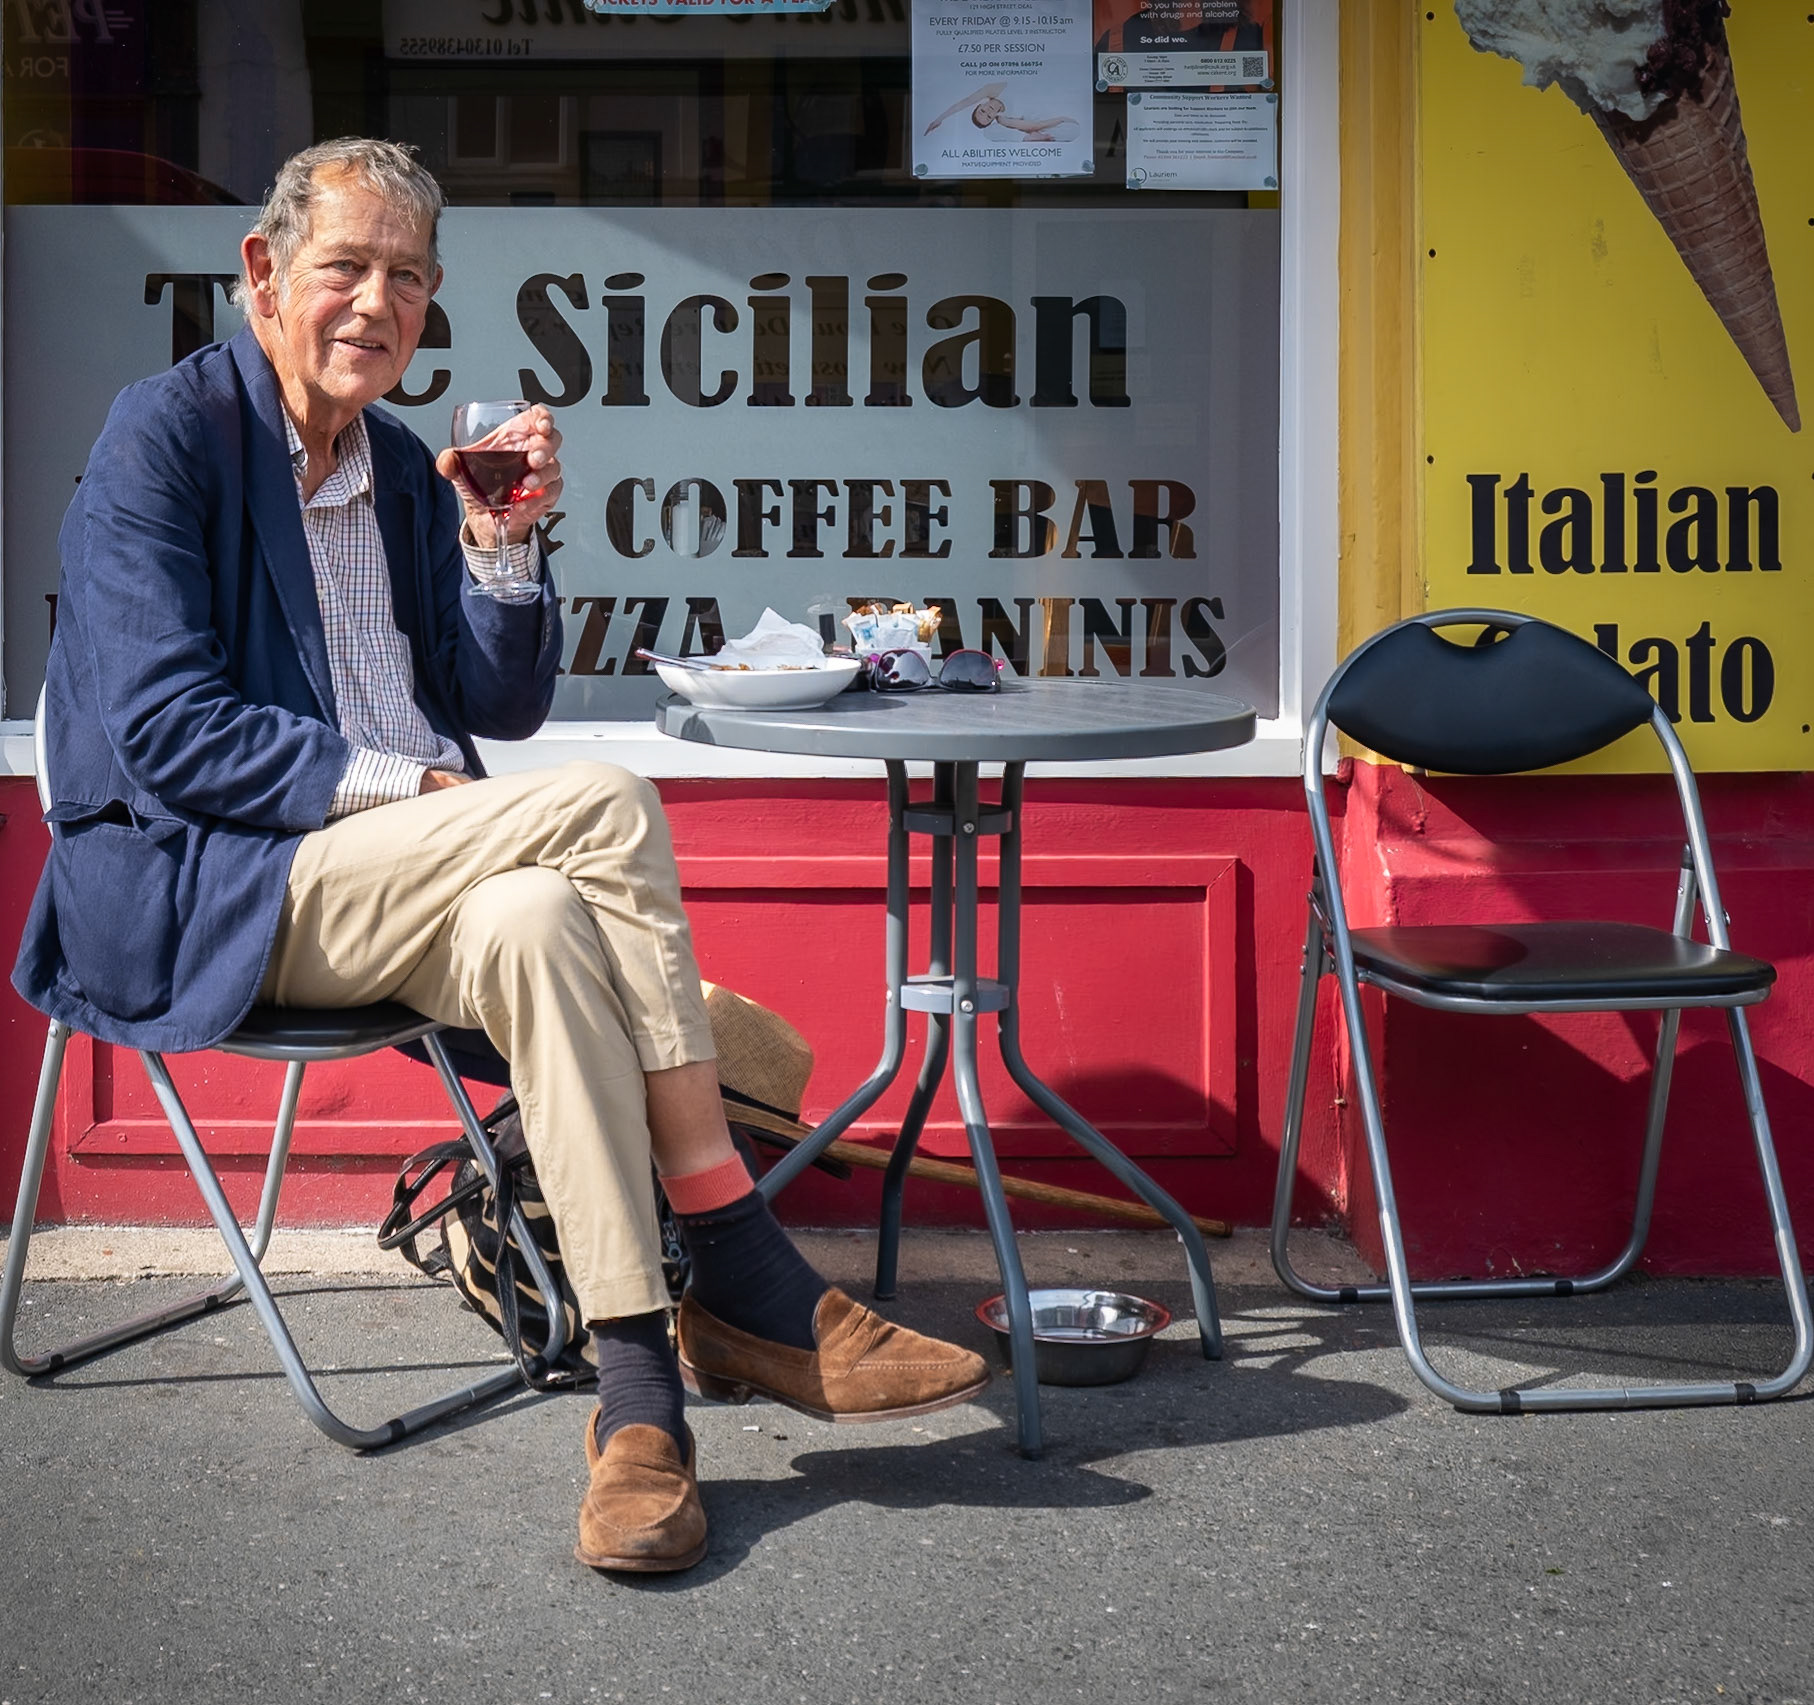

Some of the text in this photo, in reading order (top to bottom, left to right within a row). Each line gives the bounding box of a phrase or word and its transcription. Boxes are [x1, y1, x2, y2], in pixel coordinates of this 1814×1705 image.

[1140, 1, 1152, 9] Do
[1154, 2, 1170, 10] you
[1203, 1, 1237, 10] problem
[1140, 11, 1159, 19] with
[1160, 11, 1185, 20] drugs
[1205, 10, 1240, 18] alcohol?
[929, 16, 959, 26] EVERY
[962, 16, 997, 26] FRIDAY
[999, 16, 1011, 27] @
[1140, 36, 1153, 44] So
[1154, 35, 1169, 44] did
[958, 43, 1045, 53] £7.50 PER SESSION
[979, 61, 988, 69] JO
[1150, 94, 1181, 102] Community
[1182, 94, 1204, 102] Support
[941, 148, 1062, 158] ALL ABILITIES WELCOME
[143, 272, 1132, 408] Te Sicilian
[605, 477, 952, 560] COFFEE
[987, 477, 1198, 560] BAR
[1466, 470, 1782, 575] Italian
[557, 597, 726, 676] ZZA
